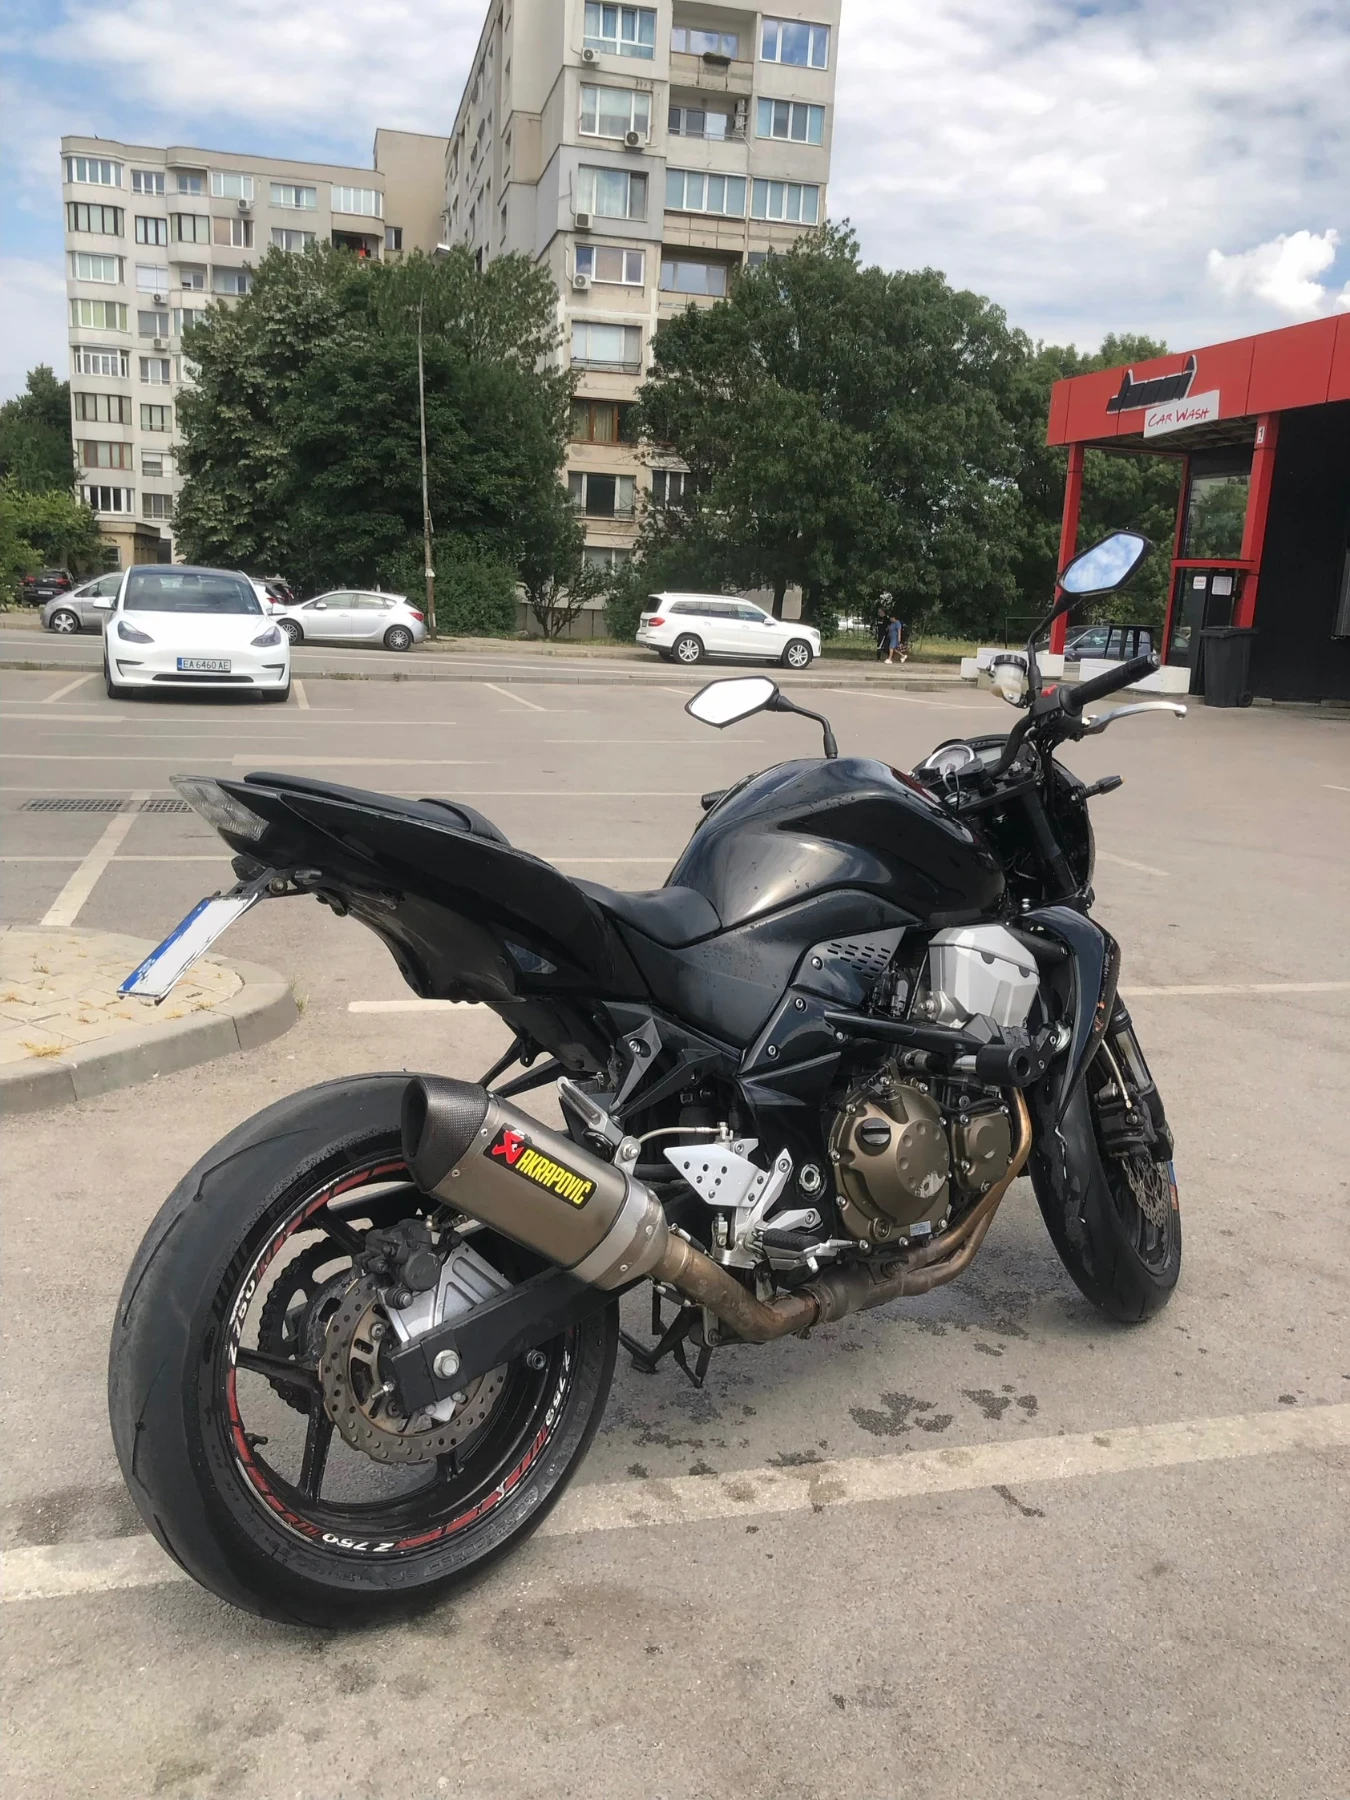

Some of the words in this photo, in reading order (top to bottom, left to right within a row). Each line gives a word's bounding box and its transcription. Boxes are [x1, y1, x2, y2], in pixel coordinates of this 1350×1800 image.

[1148, 413, 1172, 427] CAR
[1176, 407, 1209, 423] WASH
[183, 660, 194, 668] EA
[196, 660, 216, 669] 6460
[218, 661, 229, 669] AE
[228, 1340, 237, 1366] Z
[322, 1533, 369, 1551] 750
[372, 1542, 395, 1552] Z
